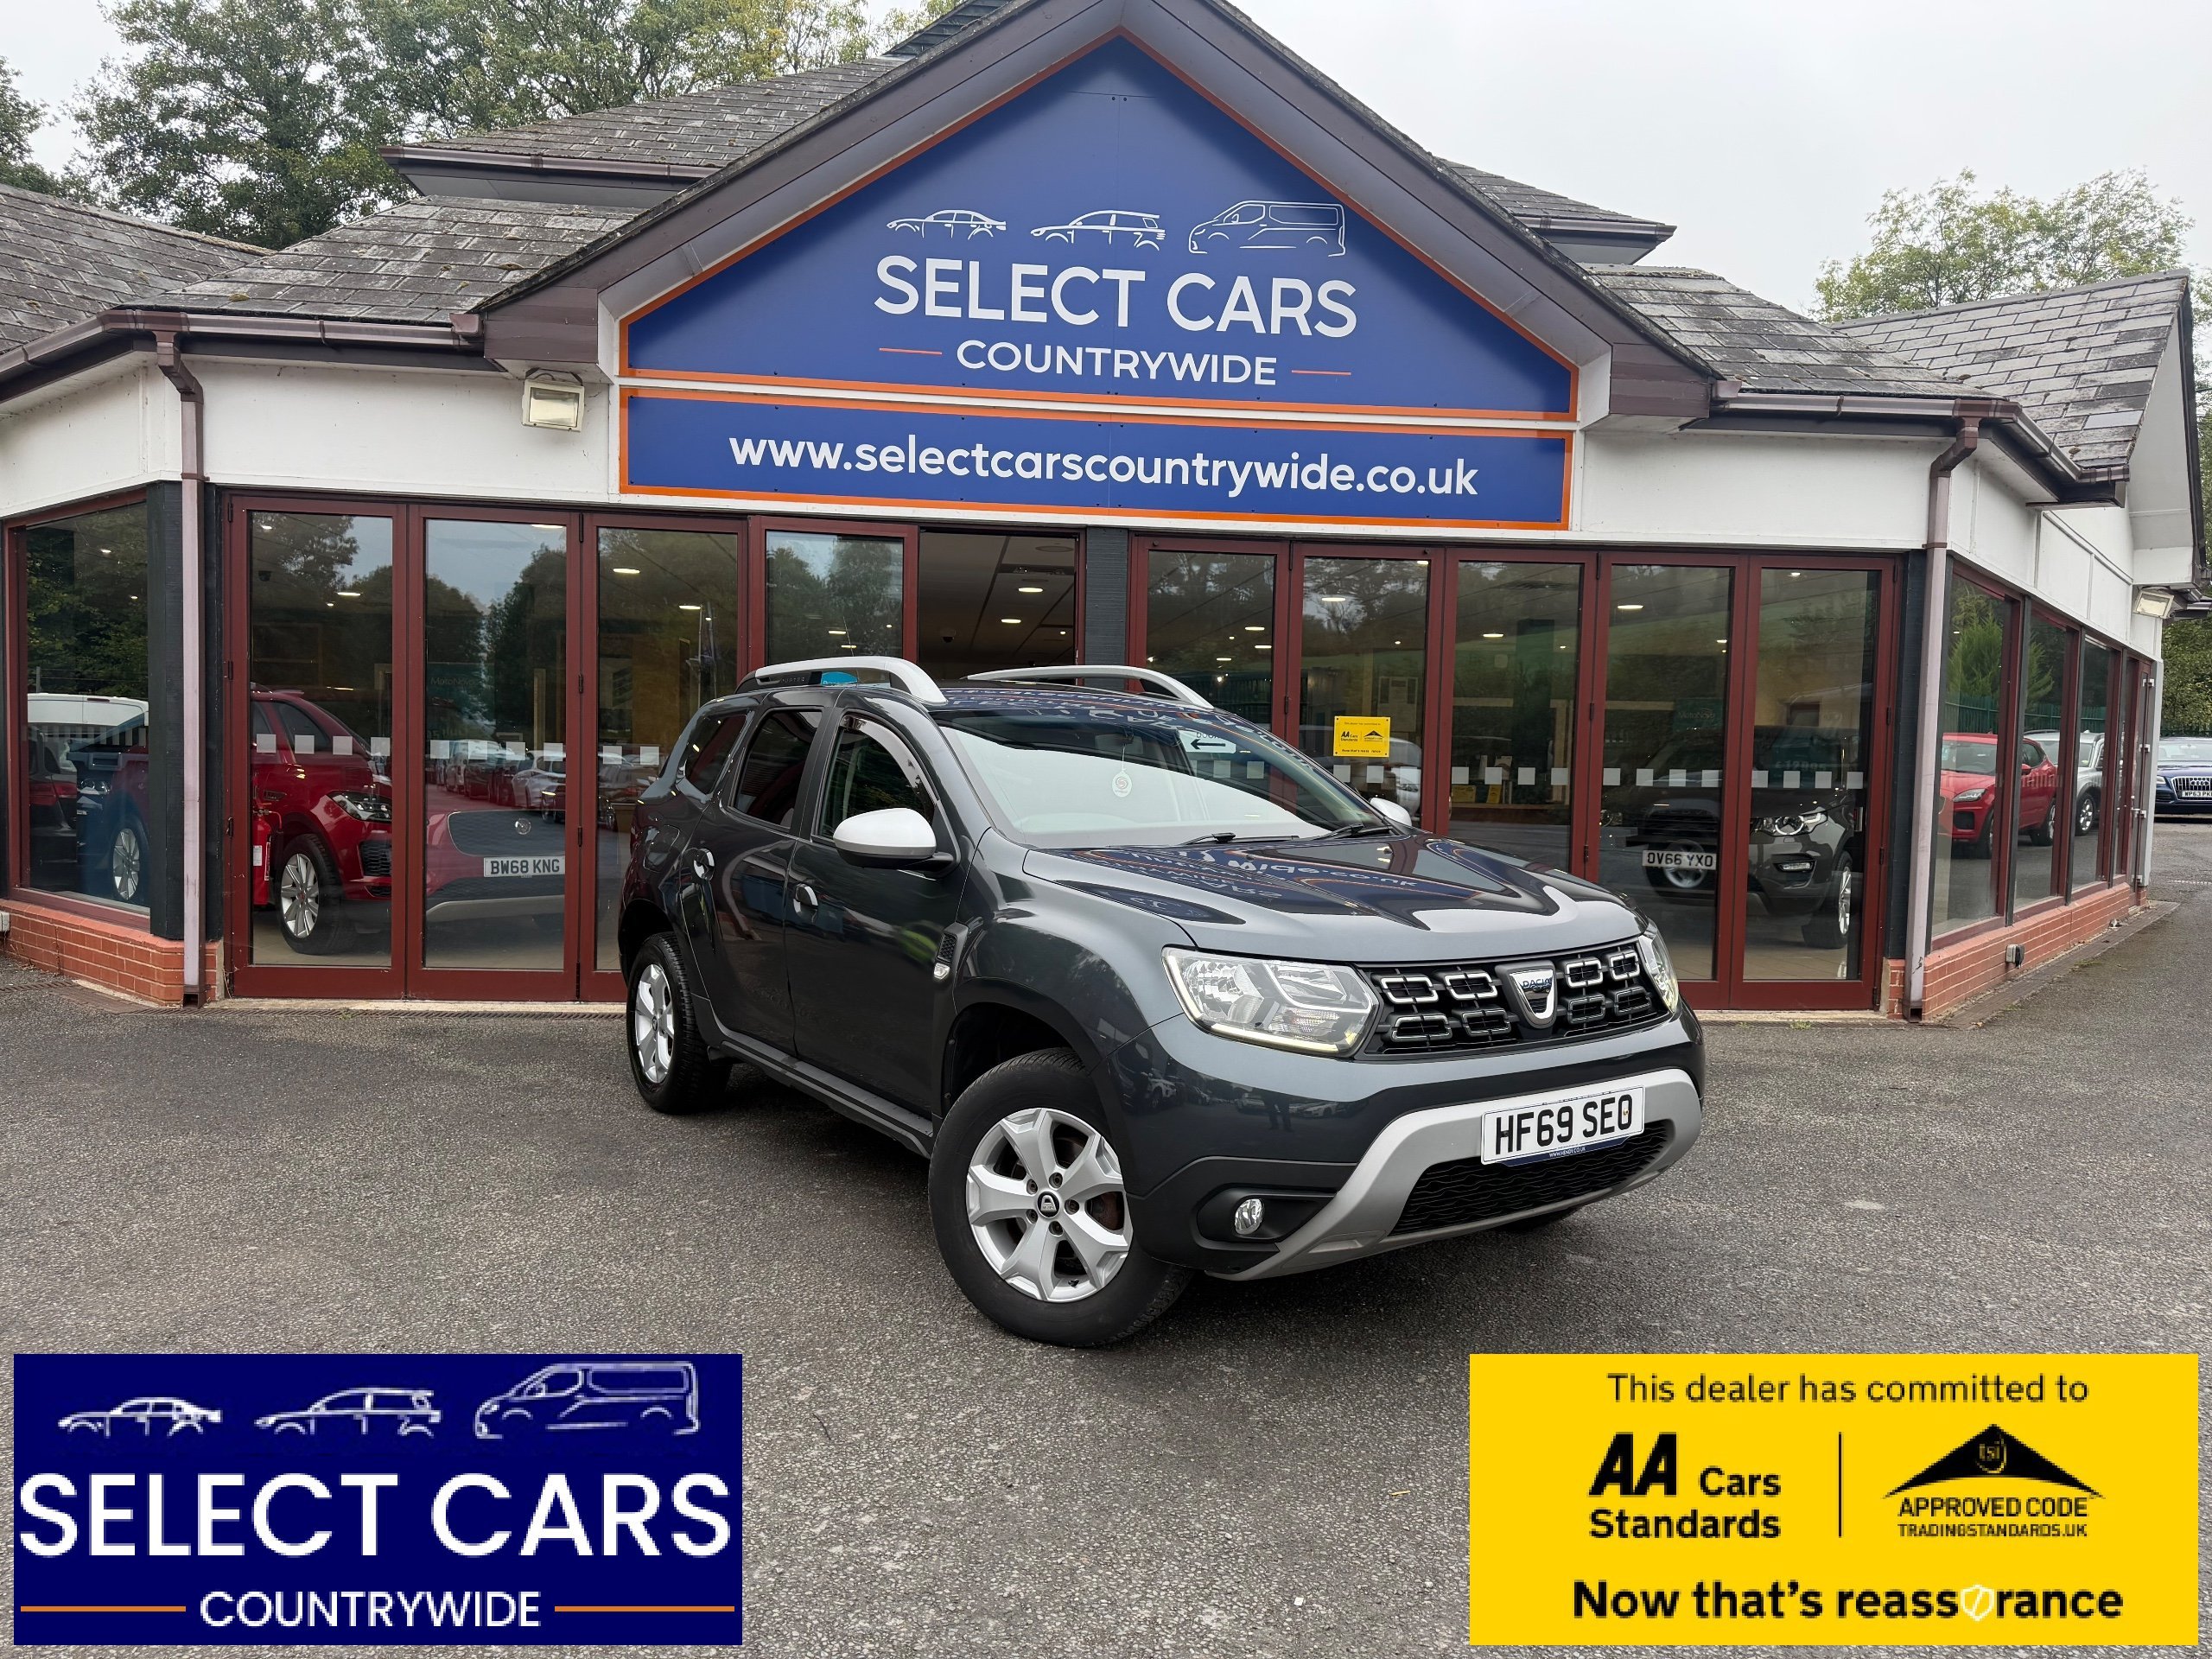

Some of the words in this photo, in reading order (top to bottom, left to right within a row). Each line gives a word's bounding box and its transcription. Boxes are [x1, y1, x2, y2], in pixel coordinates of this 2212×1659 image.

[874, 253, 1147, 327] SELECT
[1166, 270, 1357, 338] CARS
[957, 340, 1277, 386] COUNTRYWIDE
[729, 433, 1479, 499] www.selectcarscountrywide.co.uk
[490, 860, 529, 875] BW68
[533, 859, 560, 874] KNG
[1647, 852, 1682, 866] OV66
[1687, 855, 1713, 868] YXO
[1522, 977, 1553, 988] DACIA
[1495, 1105, 1573, 1155] HF69
[1582, 1094, 1633, 1138] SEO
